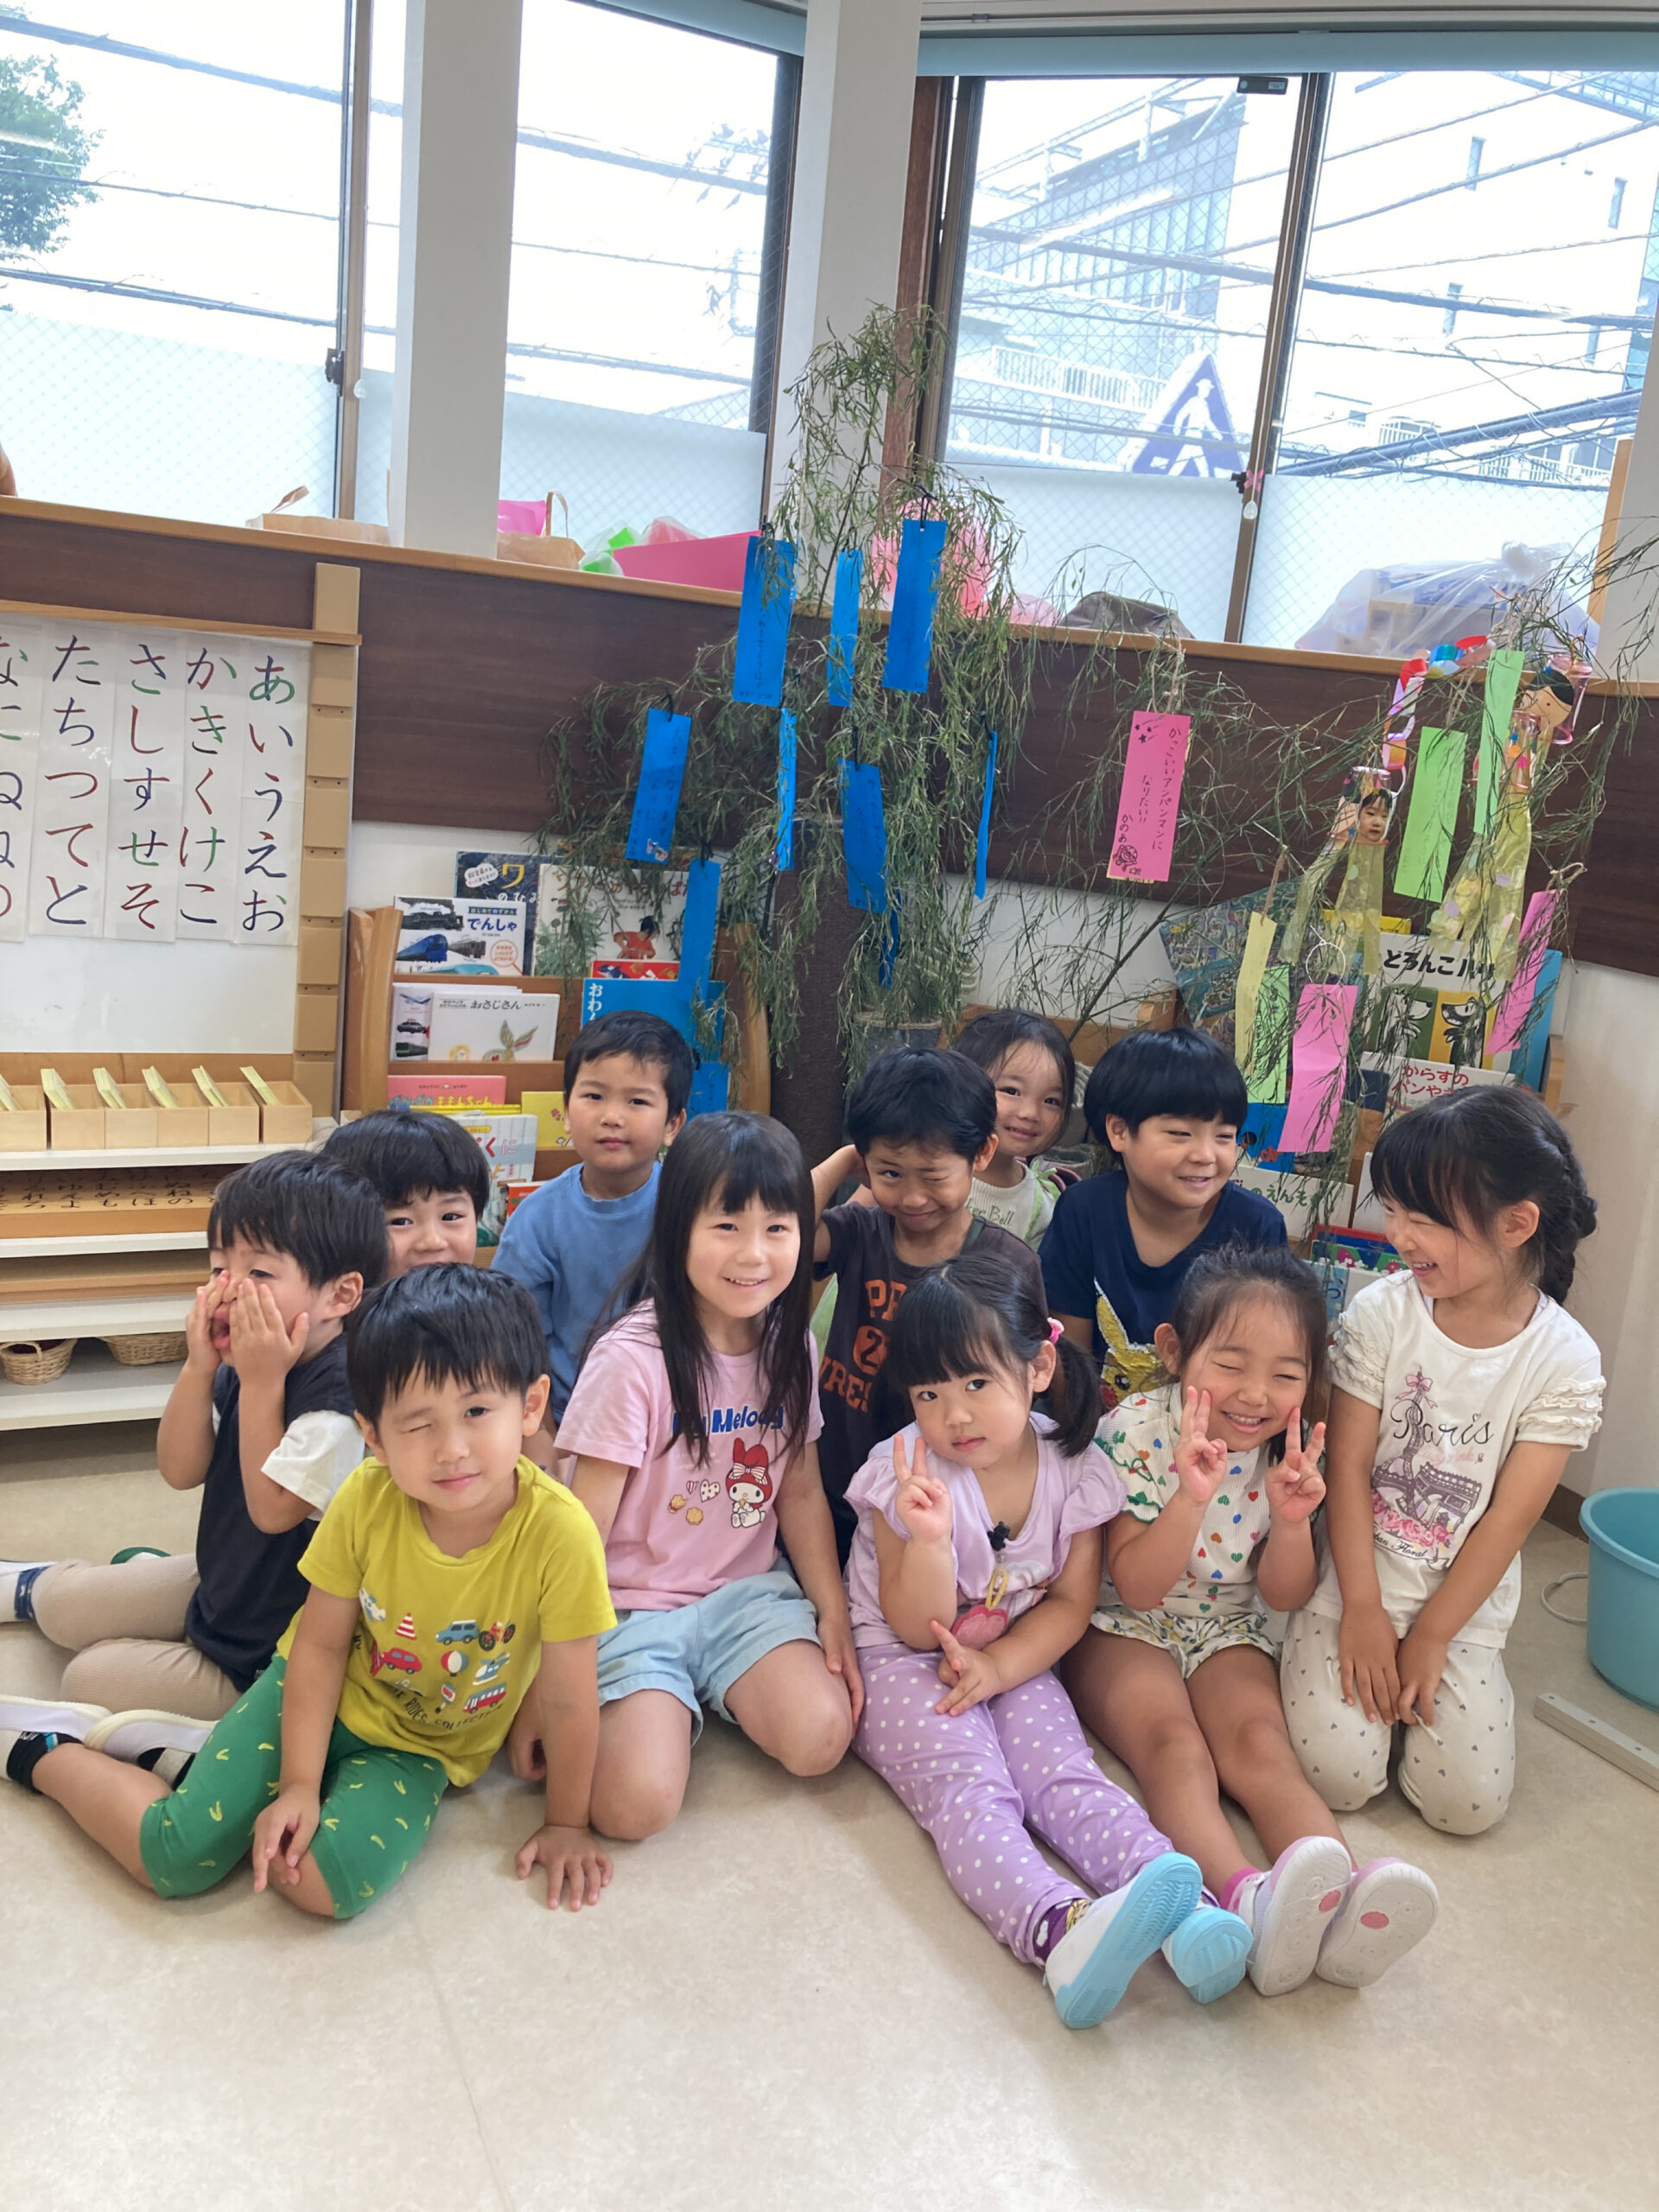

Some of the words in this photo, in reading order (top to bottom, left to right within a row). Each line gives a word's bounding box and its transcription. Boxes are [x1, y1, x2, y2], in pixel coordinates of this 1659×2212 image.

[45, 635, 102, 925] たちつてと
[118, 644, 170, 930] さしすせそ
[179, 647, 237, 925] かきくけこ
[243, 655, 296, 932] あいうえお
[1152, 728, 1182, 851] かっこいいアンパンマンに
[467, 918, 518, 932] でんしゃ
[470, 1000, 521, 1010] おさじさん
[1402, 1065, 1469, 1086] からすの
[988, 1205, 1015, 1226] Bell
[1390, 1398, 1495, 1446] Paris
[1391, 1540, 1428, 1557] Floral
